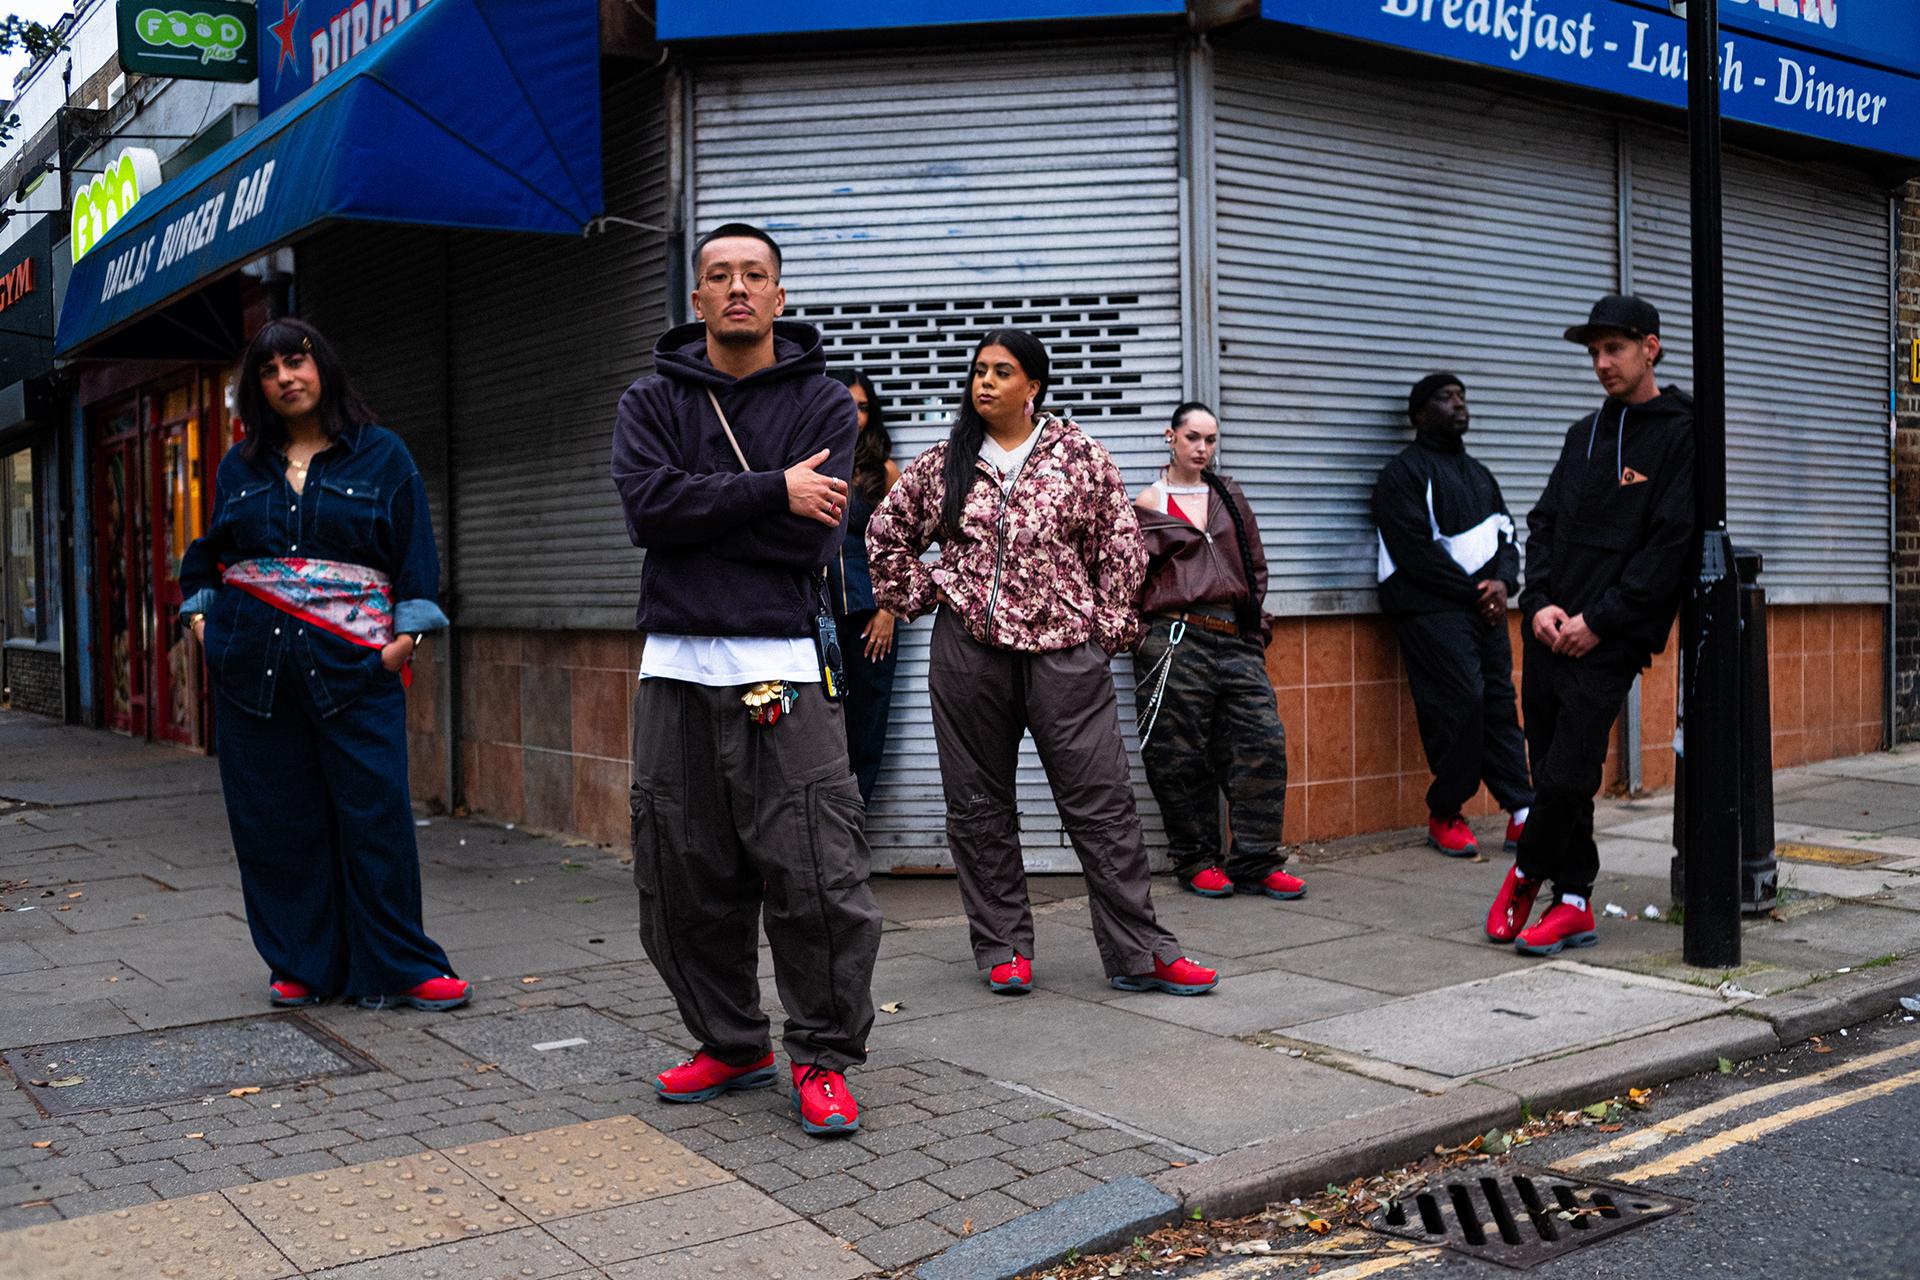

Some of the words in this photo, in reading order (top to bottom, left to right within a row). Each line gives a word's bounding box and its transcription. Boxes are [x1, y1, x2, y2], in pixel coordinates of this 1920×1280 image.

[147, 17, 238, 42] FOOD
[1628, 20, 1743, 93] Luh
[1774, 57, 1887, 125] Dinner
[101, 235, 156, 304] DALLAS
[156, 191, 226, 273] BURGER
[227, 159, 276, 232] BAR
